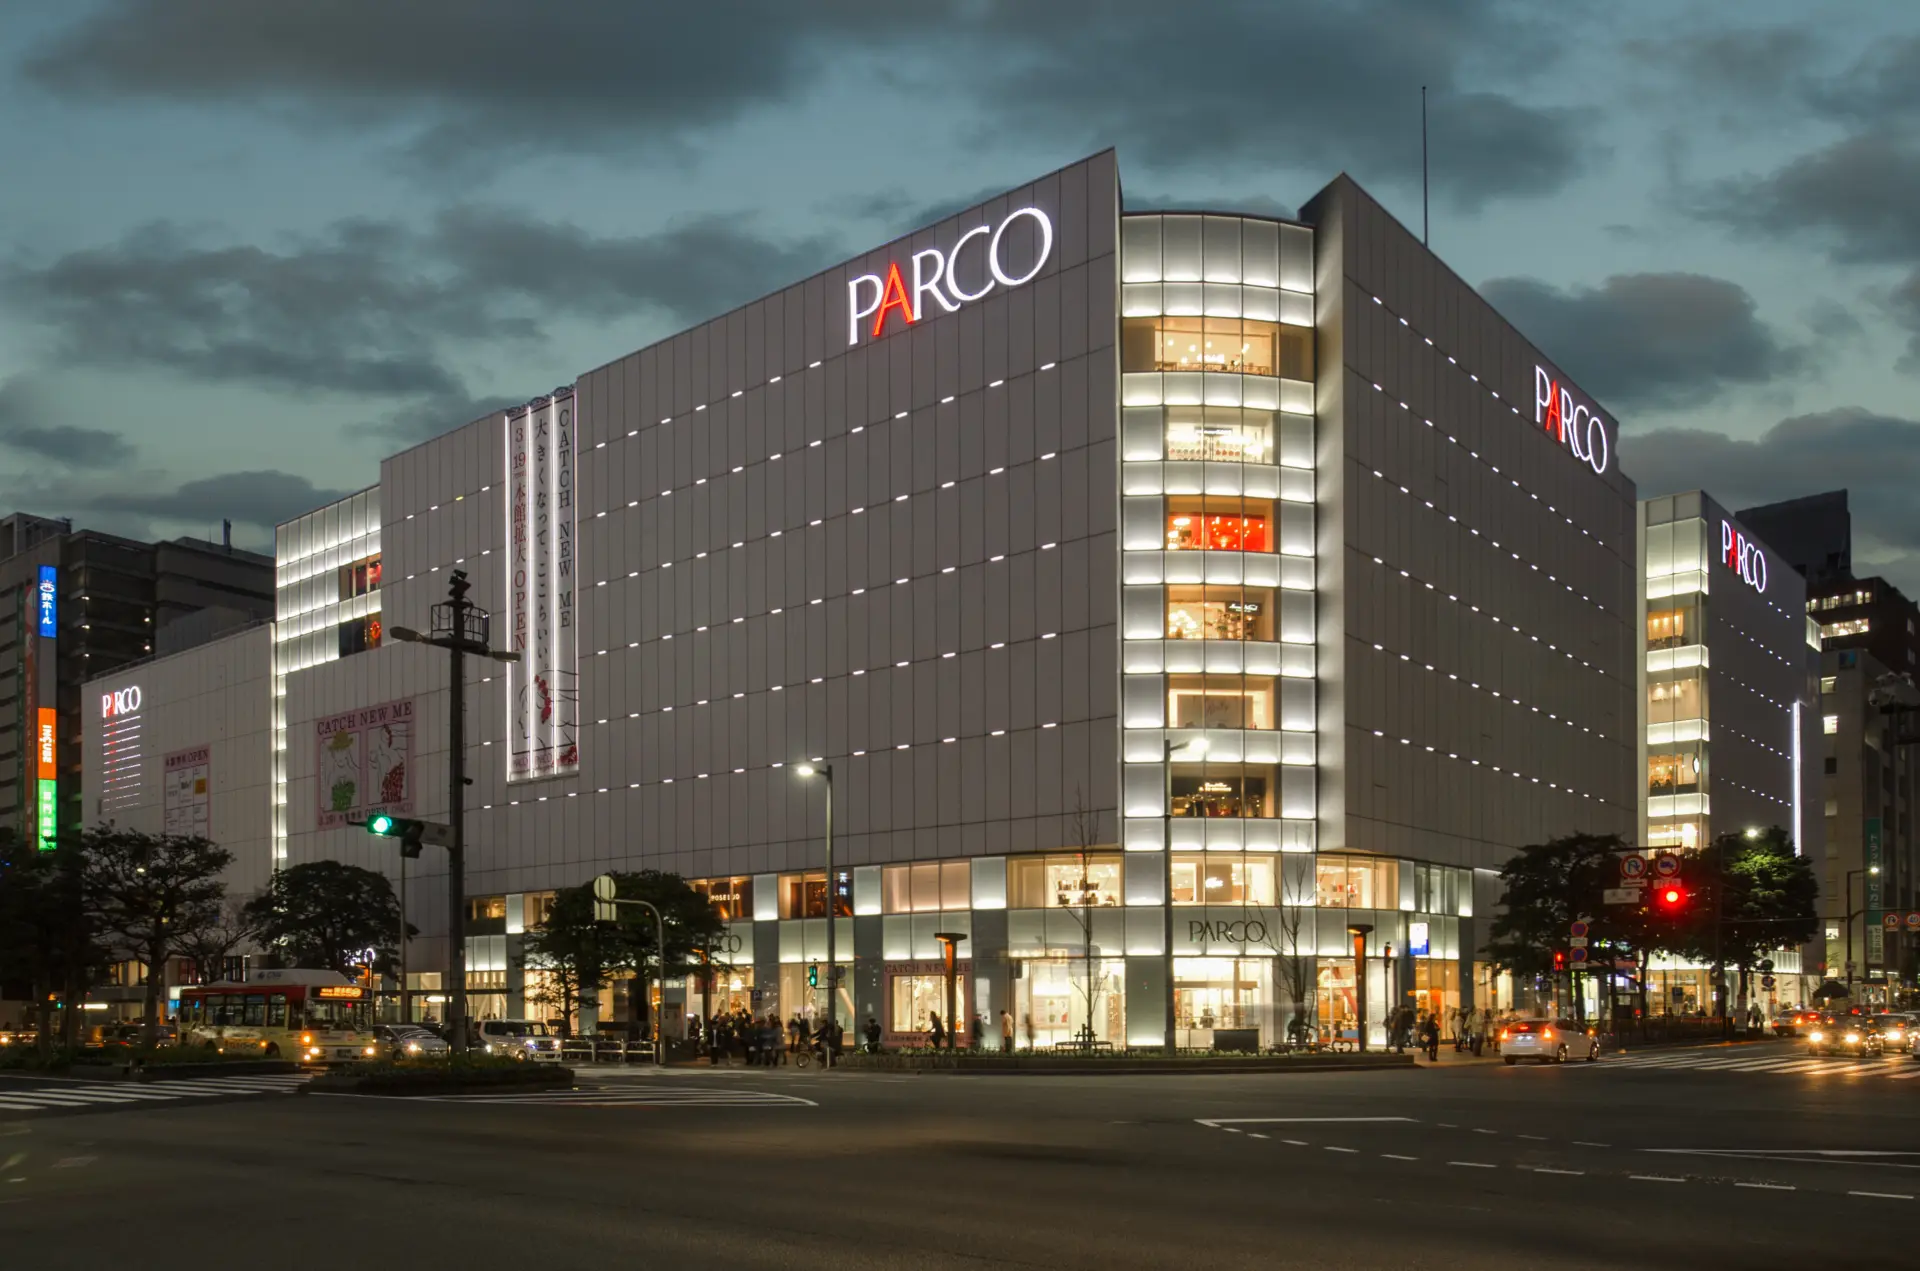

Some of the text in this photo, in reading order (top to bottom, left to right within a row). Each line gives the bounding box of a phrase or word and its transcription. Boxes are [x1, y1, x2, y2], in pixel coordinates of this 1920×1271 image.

[849, 207, 1053, 346] PARCO
[1535, 364, 1608, 474] PARCO
[558, 409, 572, 629] CATCH NEW ME
[1721, 519, 1767, 594] PARCO
[513, 569, 527, 652] OPEN
[102, 685, 142, 718] PARCO
[317, 701, 412, 736] CATCH NEW ME
[1188, 920, 1266, 943] PARCO
